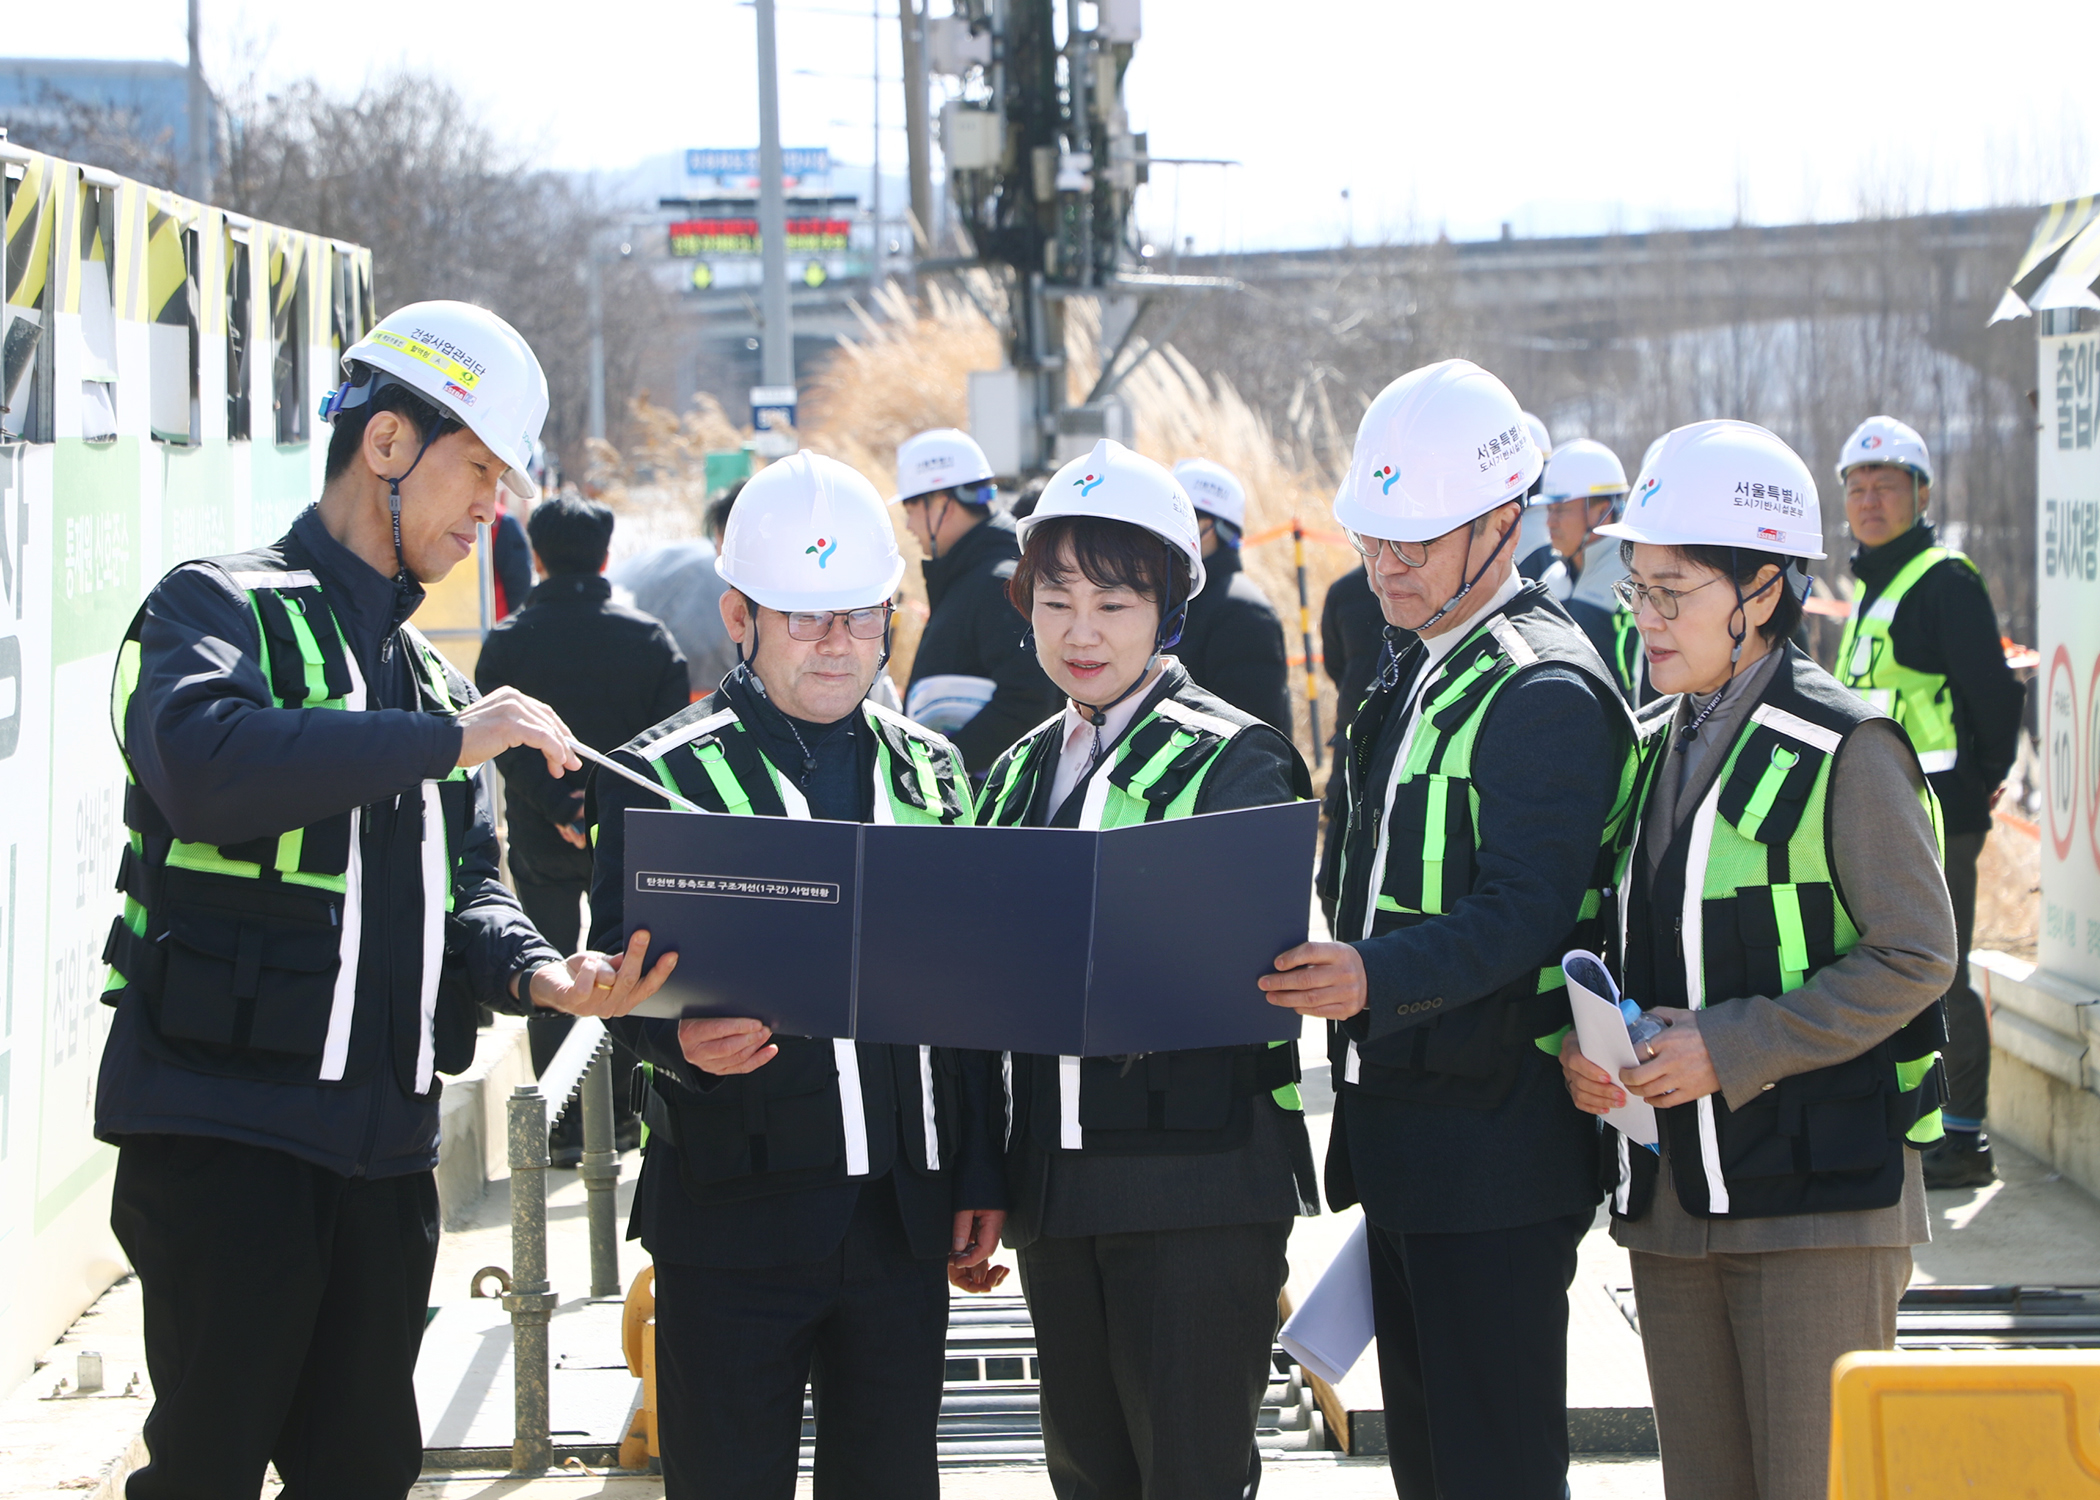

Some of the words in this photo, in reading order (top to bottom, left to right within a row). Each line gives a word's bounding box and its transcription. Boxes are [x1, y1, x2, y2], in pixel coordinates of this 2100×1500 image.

[410, 327, 487, 376] 건설사업관리단
[1733, 497, 1804, 518] 도시기반시설본부
[1734, 481, 1804, 508] 서울특별시
[65, 514, 93, 600] 통제원
[95, 510, 130, 591] 신호준수
[2045, 500, 2099, 581] 공사차량
[2053, 730, 2071, 813] 10
[75, 780, 115, 910] 앞바퀴
[646, 876, 676, 888] 탄천변
[677, 878, 716, 890] 동측도로
[717, 881, 789, 895] 구조개선(1구간)
[790, 885, 830, 898] 사업현황
[53, 940, 82, 1069] 진입
